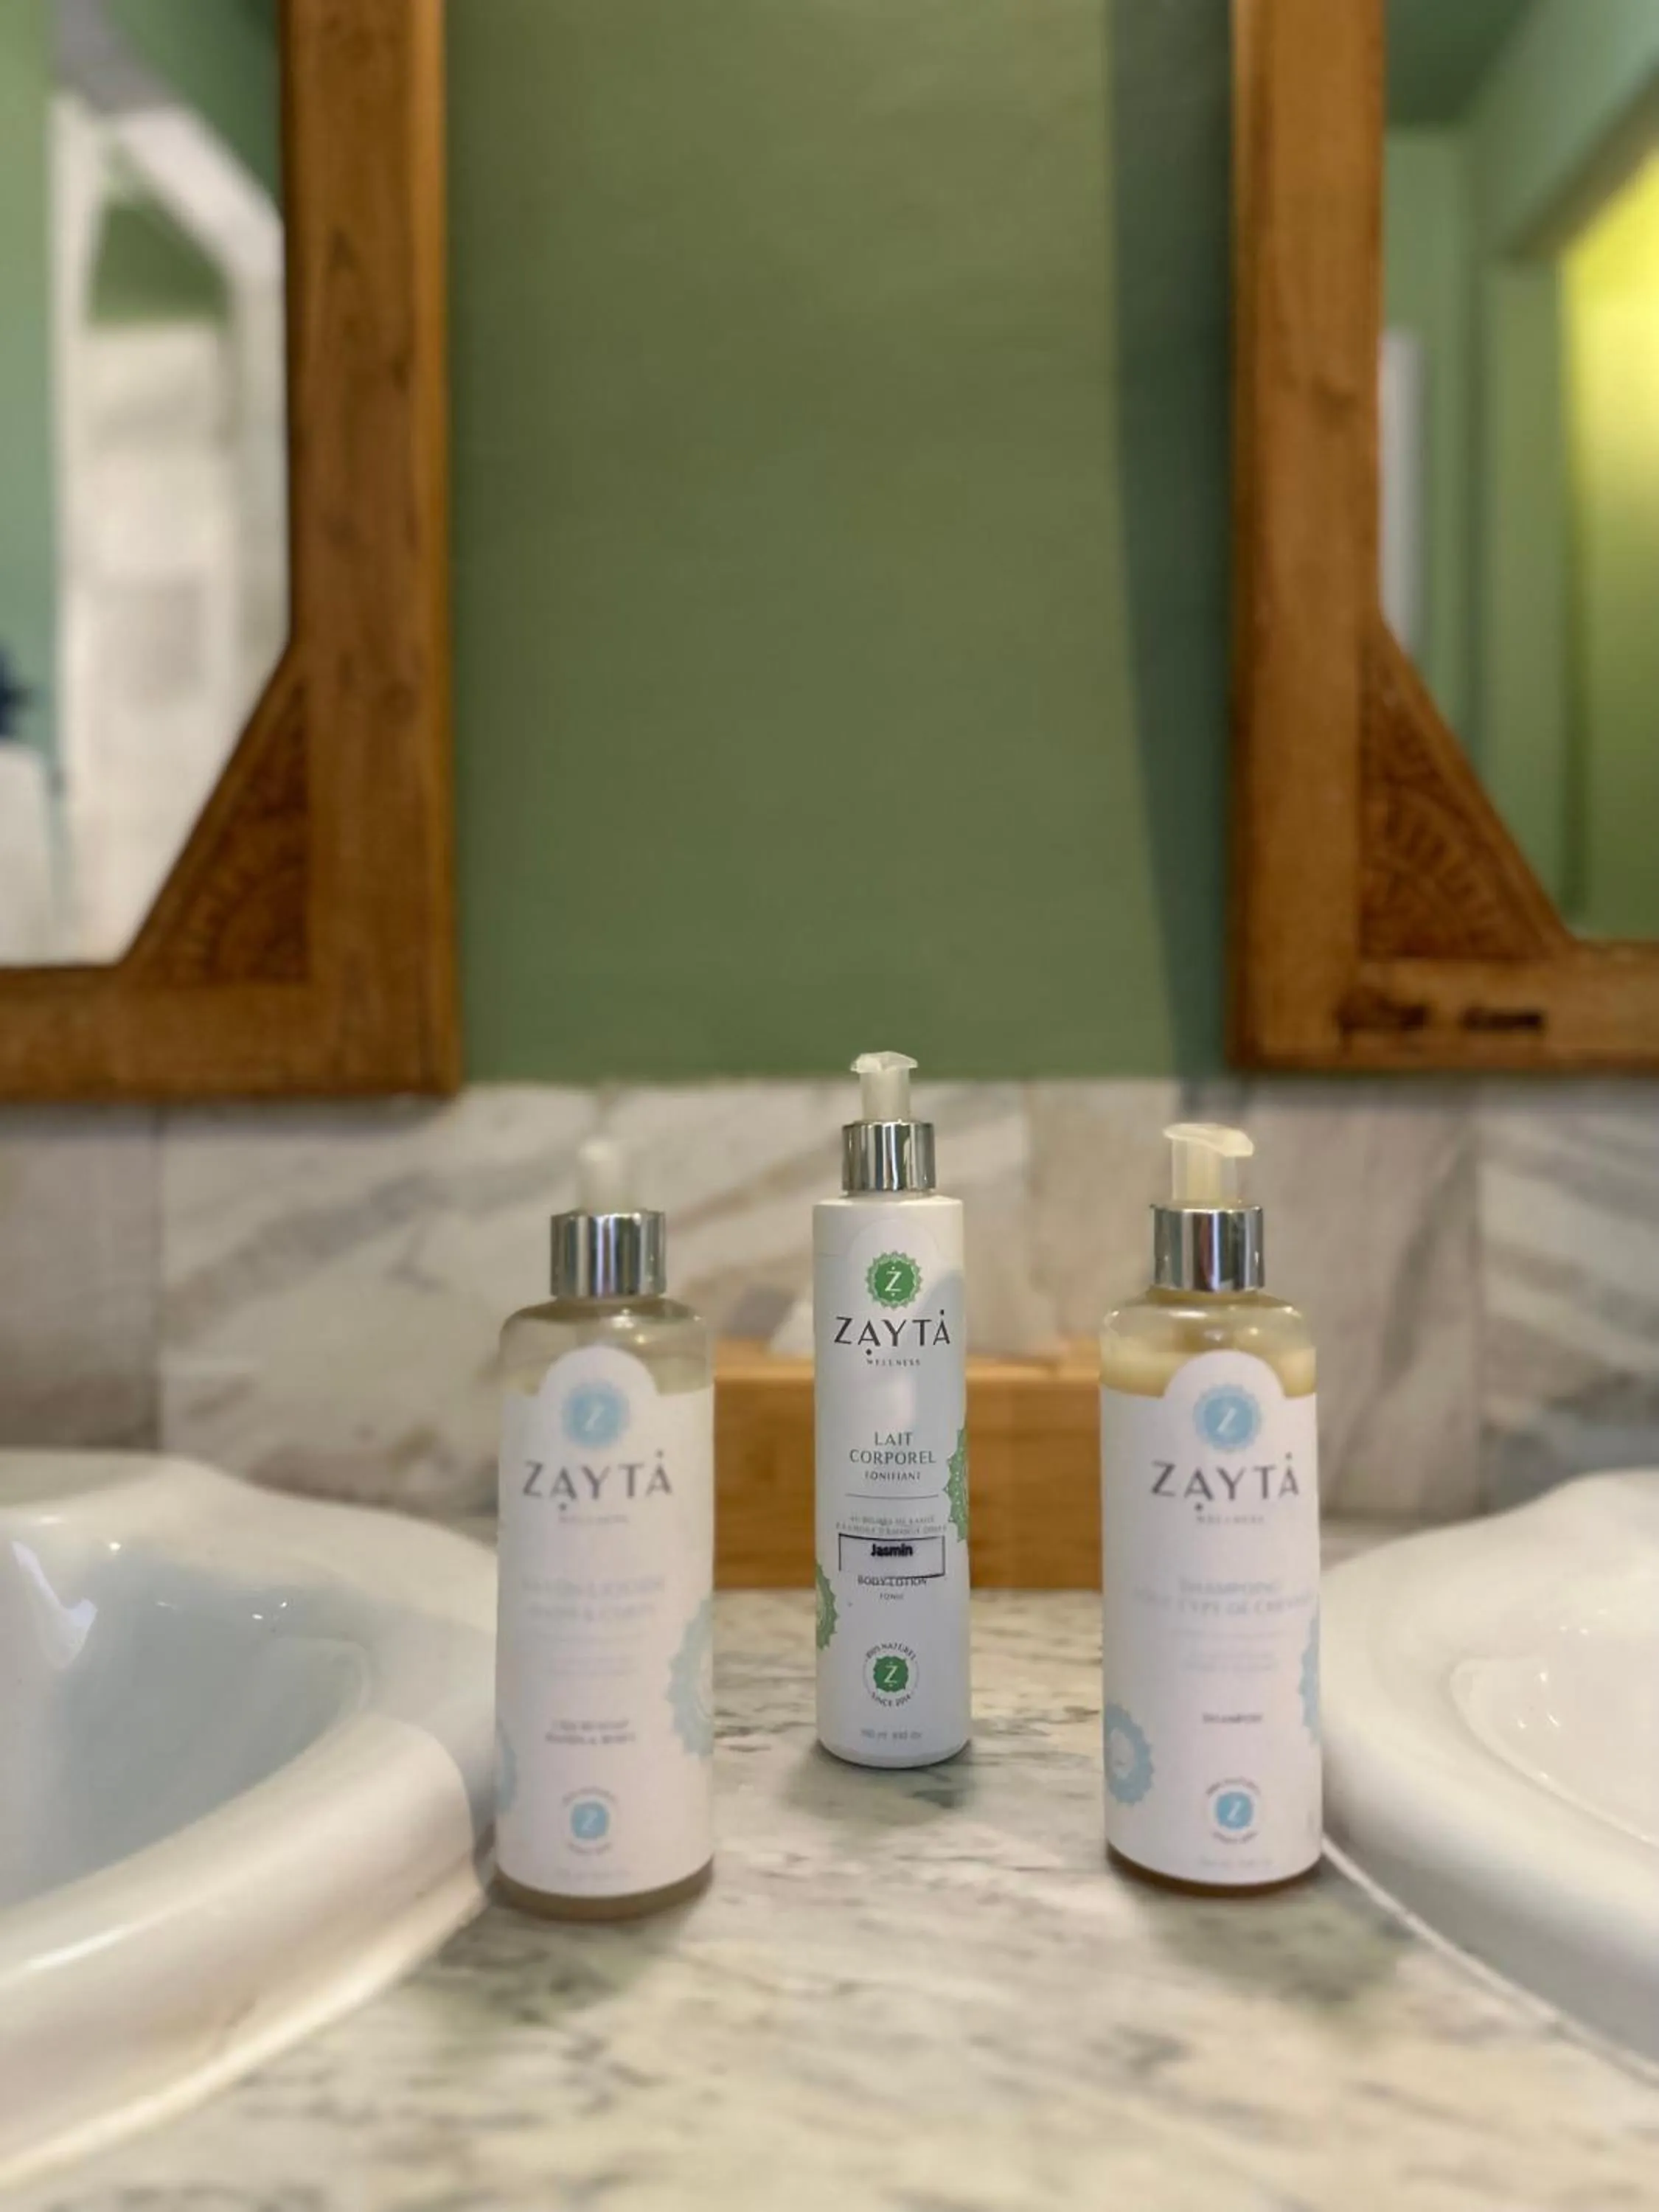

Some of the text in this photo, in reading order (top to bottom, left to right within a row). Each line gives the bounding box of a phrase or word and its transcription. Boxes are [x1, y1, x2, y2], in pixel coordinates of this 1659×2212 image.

[866, 1358, 921, 1367] WELLNESS
[874, 1431, 913, 1447] LAIT
[849, 1448, 936, 1465] CORPOREL
[871, 1543, 914, 1557] Jasmin
